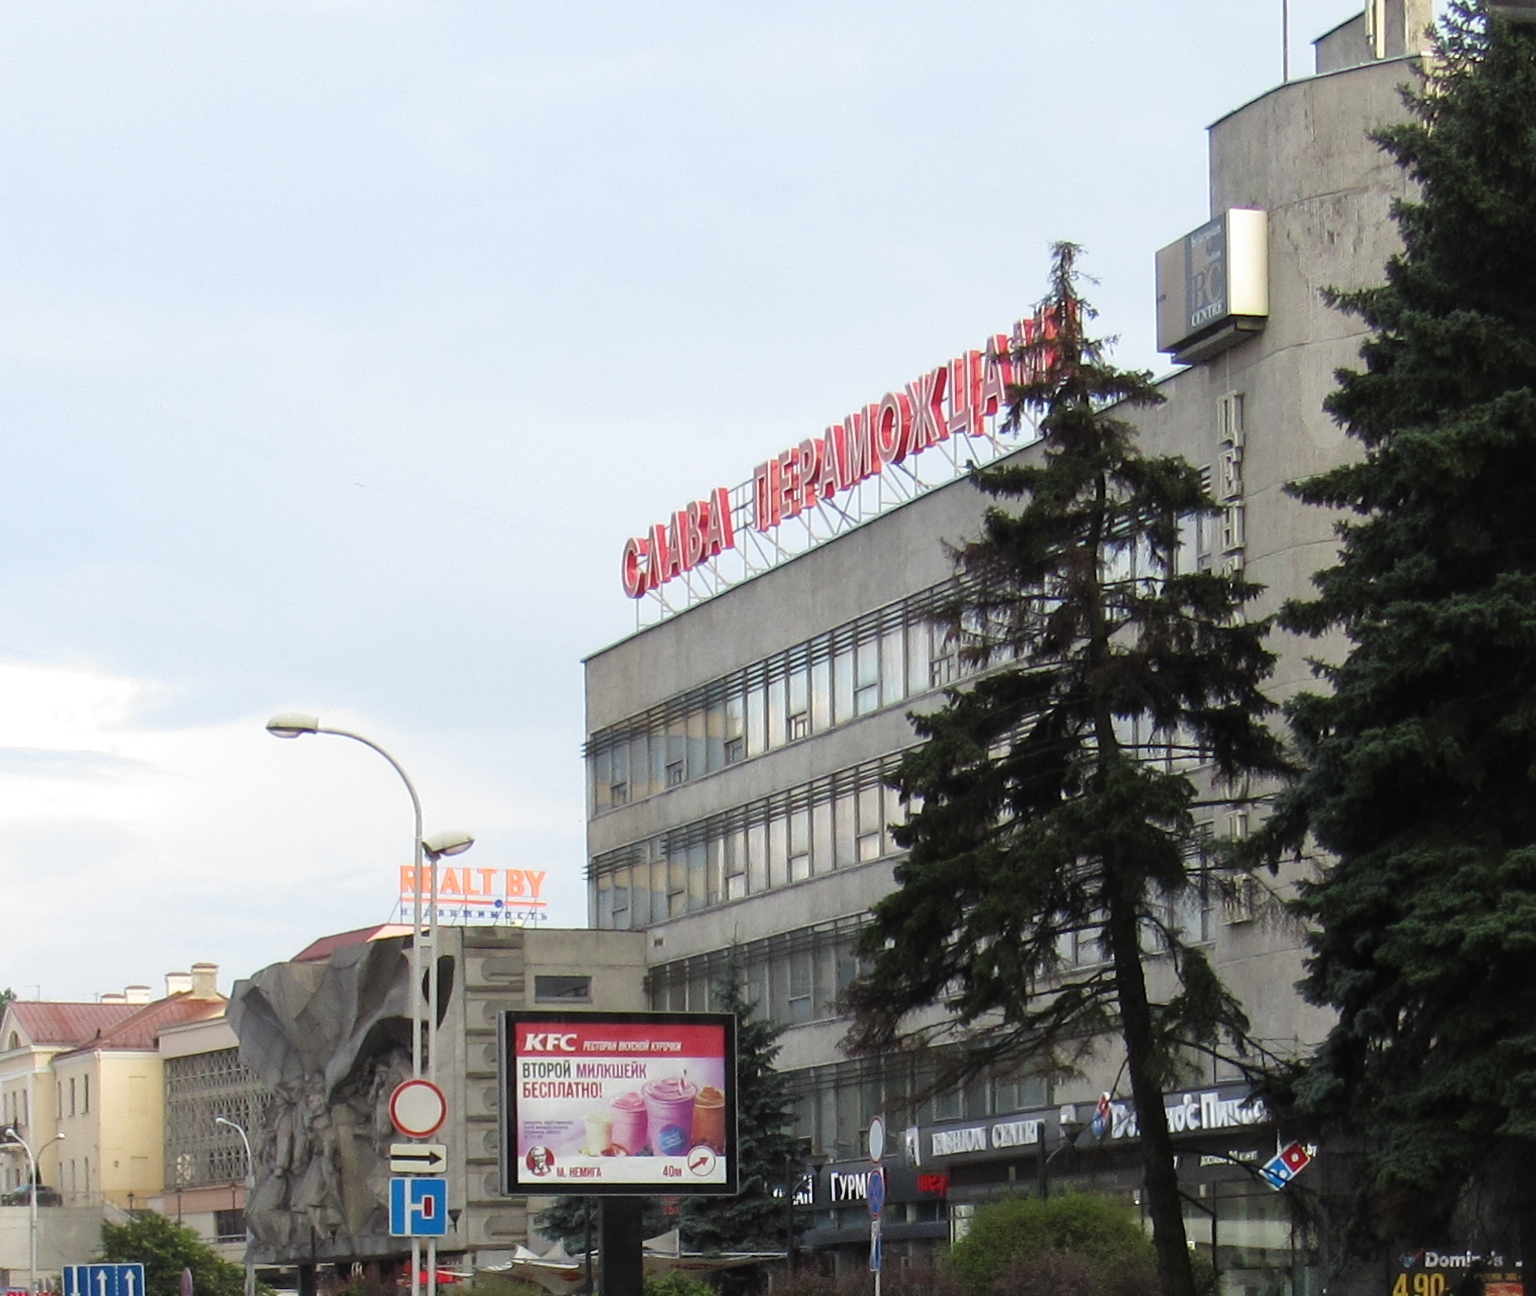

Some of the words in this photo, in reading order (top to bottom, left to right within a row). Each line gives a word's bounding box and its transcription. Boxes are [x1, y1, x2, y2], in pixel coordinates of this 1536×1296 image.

[1191, 300, 1223, 328] CENTRE
[621, 487, 734, 599] СЛАВА
[506, 868, 547, 898] BY
[524, 1033, 578, 1051] KFC
[522, 1060, 571, 1078] ВТОРОЙ
[576, 1060, 647, 1079] МИЛКШЕЙК
[522, 1081, 602, 1099] БЕСПЛАТНО!
[569, 1166, 602, 1178] НЕМИГА
[1425, 1250, 1504, 1267] Domi's
